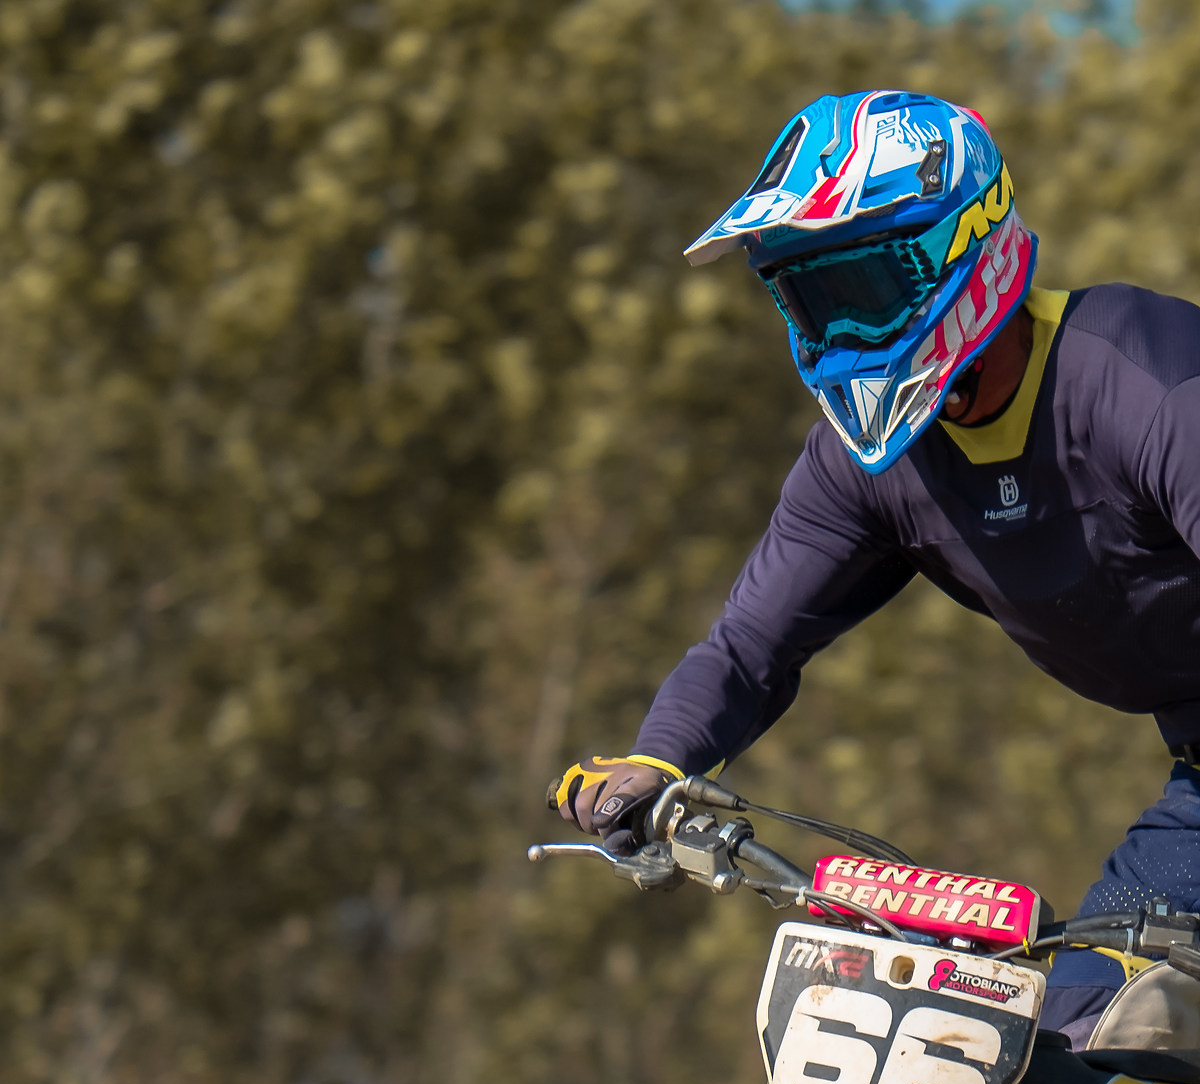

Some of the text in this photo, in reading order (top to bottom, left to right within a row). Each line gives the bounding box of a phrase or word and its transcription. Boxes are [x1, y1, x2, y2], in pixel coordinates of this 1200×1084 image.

[824, 857, 1021, 904] RENTHAL
[824, 881, 1015, 932] RENTHAL
[944, 981, 1008, 1002] MOTORSPORT
